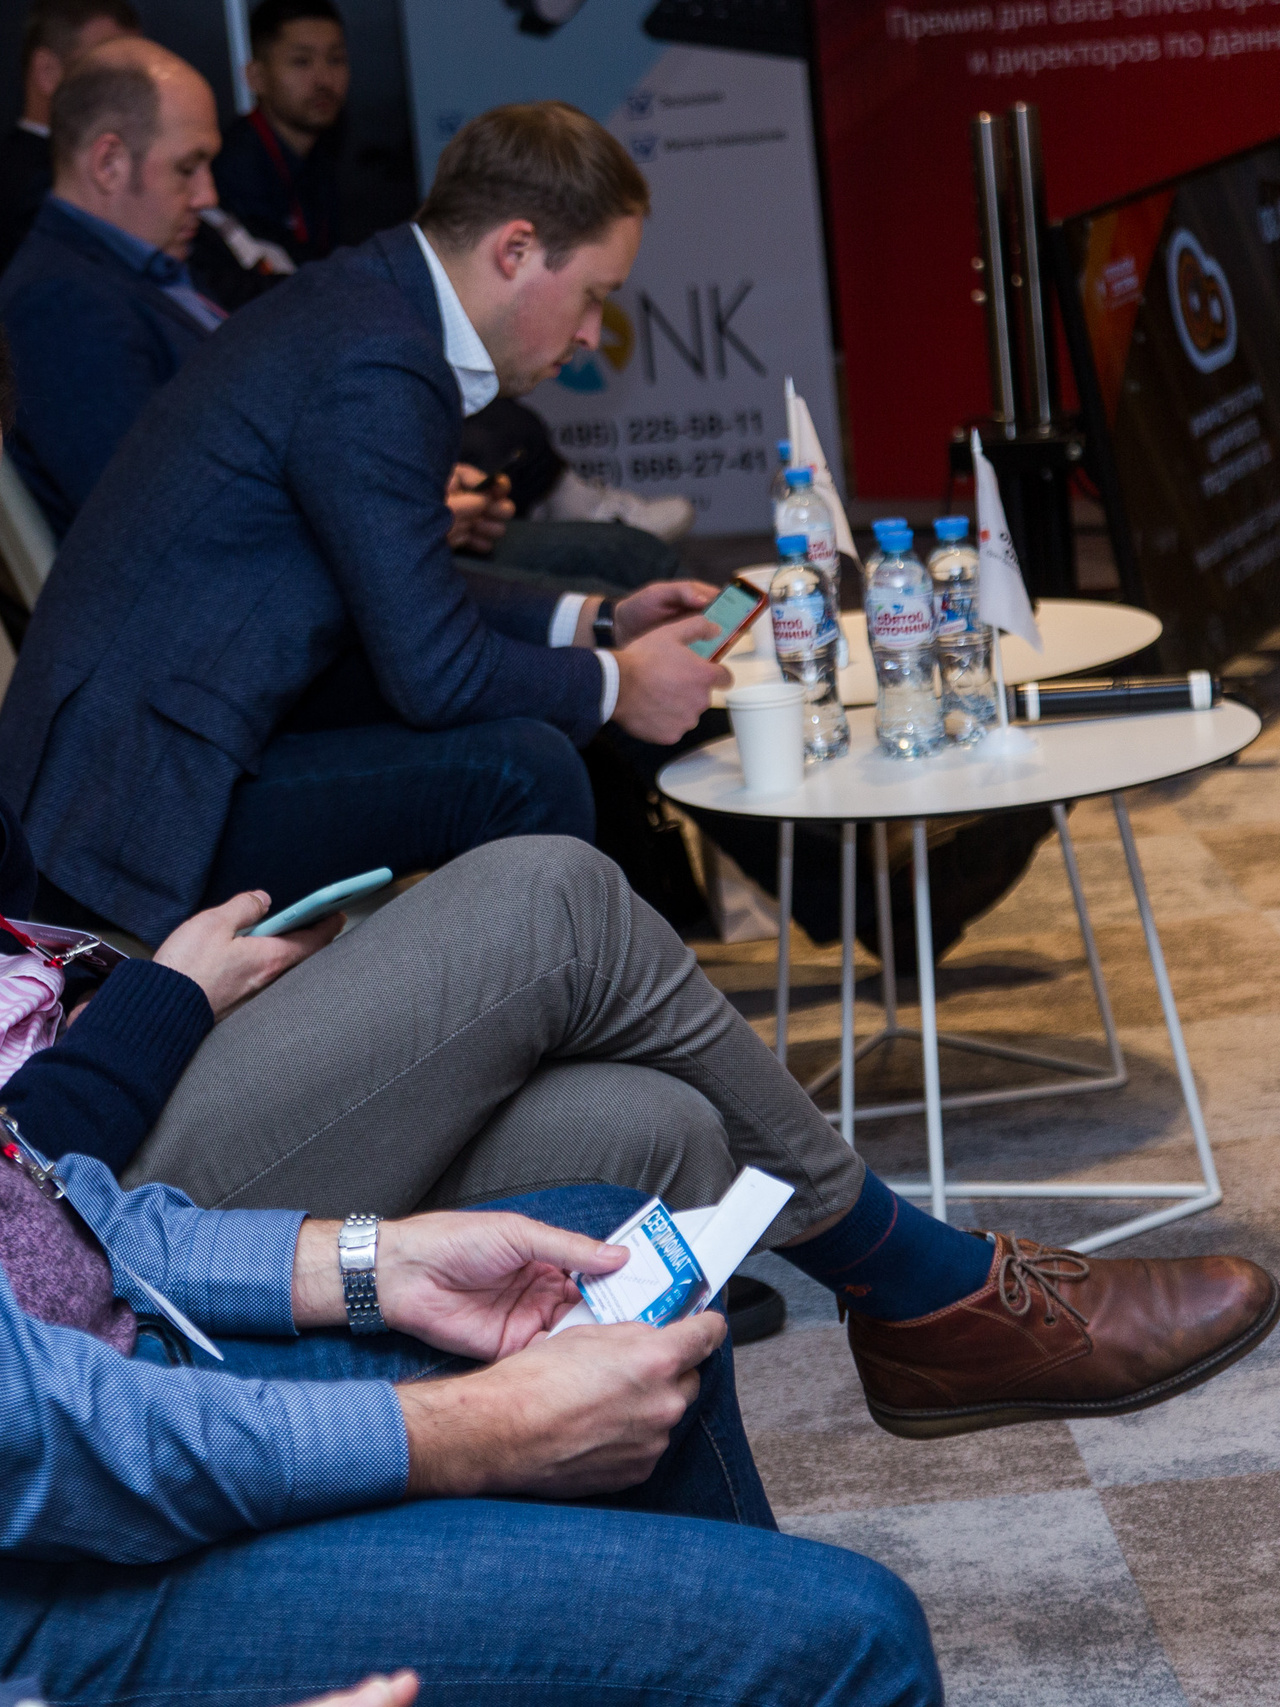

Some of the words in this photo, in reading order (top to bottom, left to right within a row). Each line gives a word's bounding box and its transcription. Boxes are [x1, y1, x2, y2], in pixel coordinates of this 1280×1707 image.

[886, 6, 994, 42] Премия
[995, 3, 1048, 32] для
[967, 50, 990, 76] и
[991, 35, 1161, 78] директоров
[1163, 31, 1205, 58] по
[645, 1210, 692, 1273] СЕРТИФИКАТ
